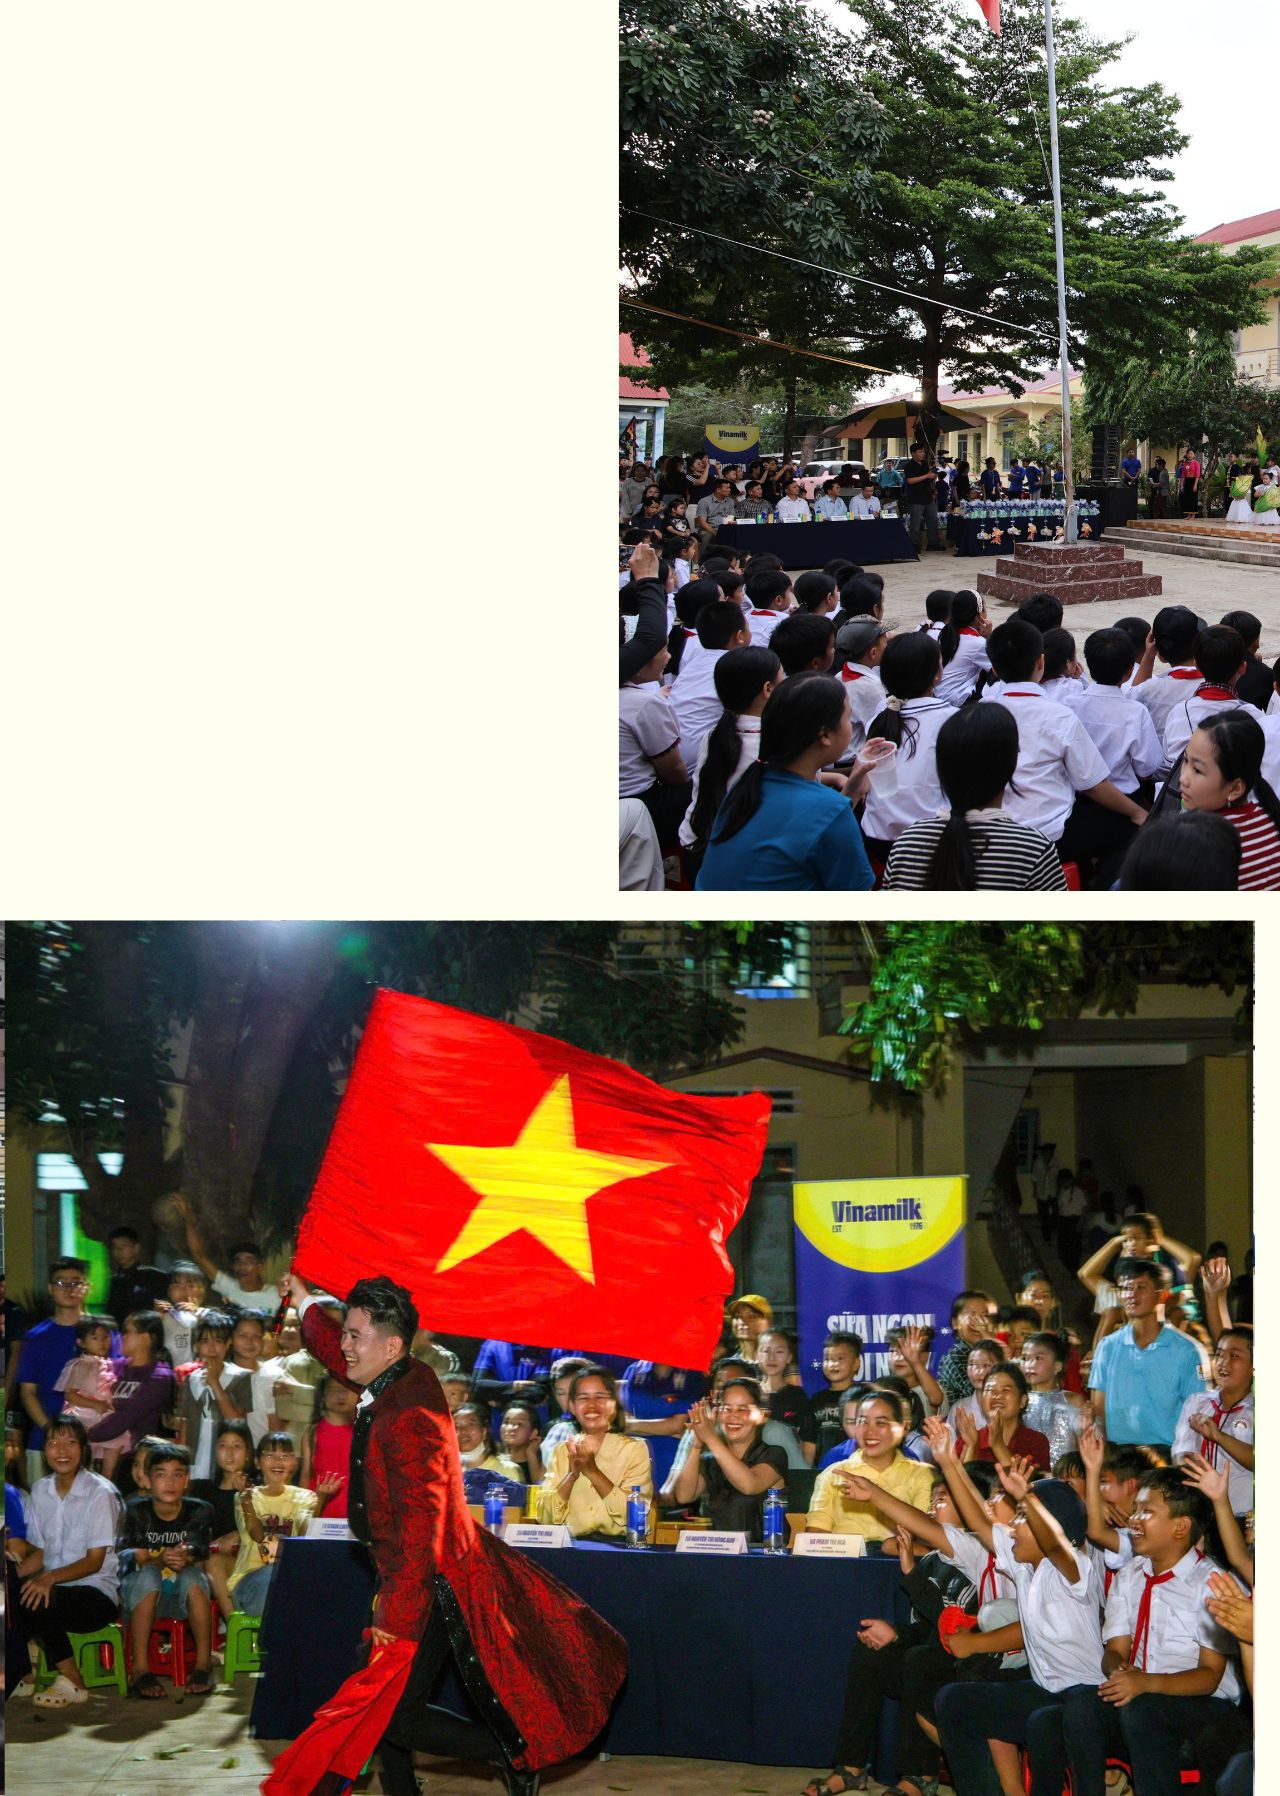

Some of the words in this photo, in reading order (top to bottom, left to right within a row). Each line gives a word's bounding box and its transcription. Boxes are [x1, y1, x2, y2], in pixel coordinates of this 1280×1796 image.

[719, 430, 747, 438] Vinamilk
[832, 1198, 922, 1223] Vinamilk
[832, 1225, 842, 1233] EST
